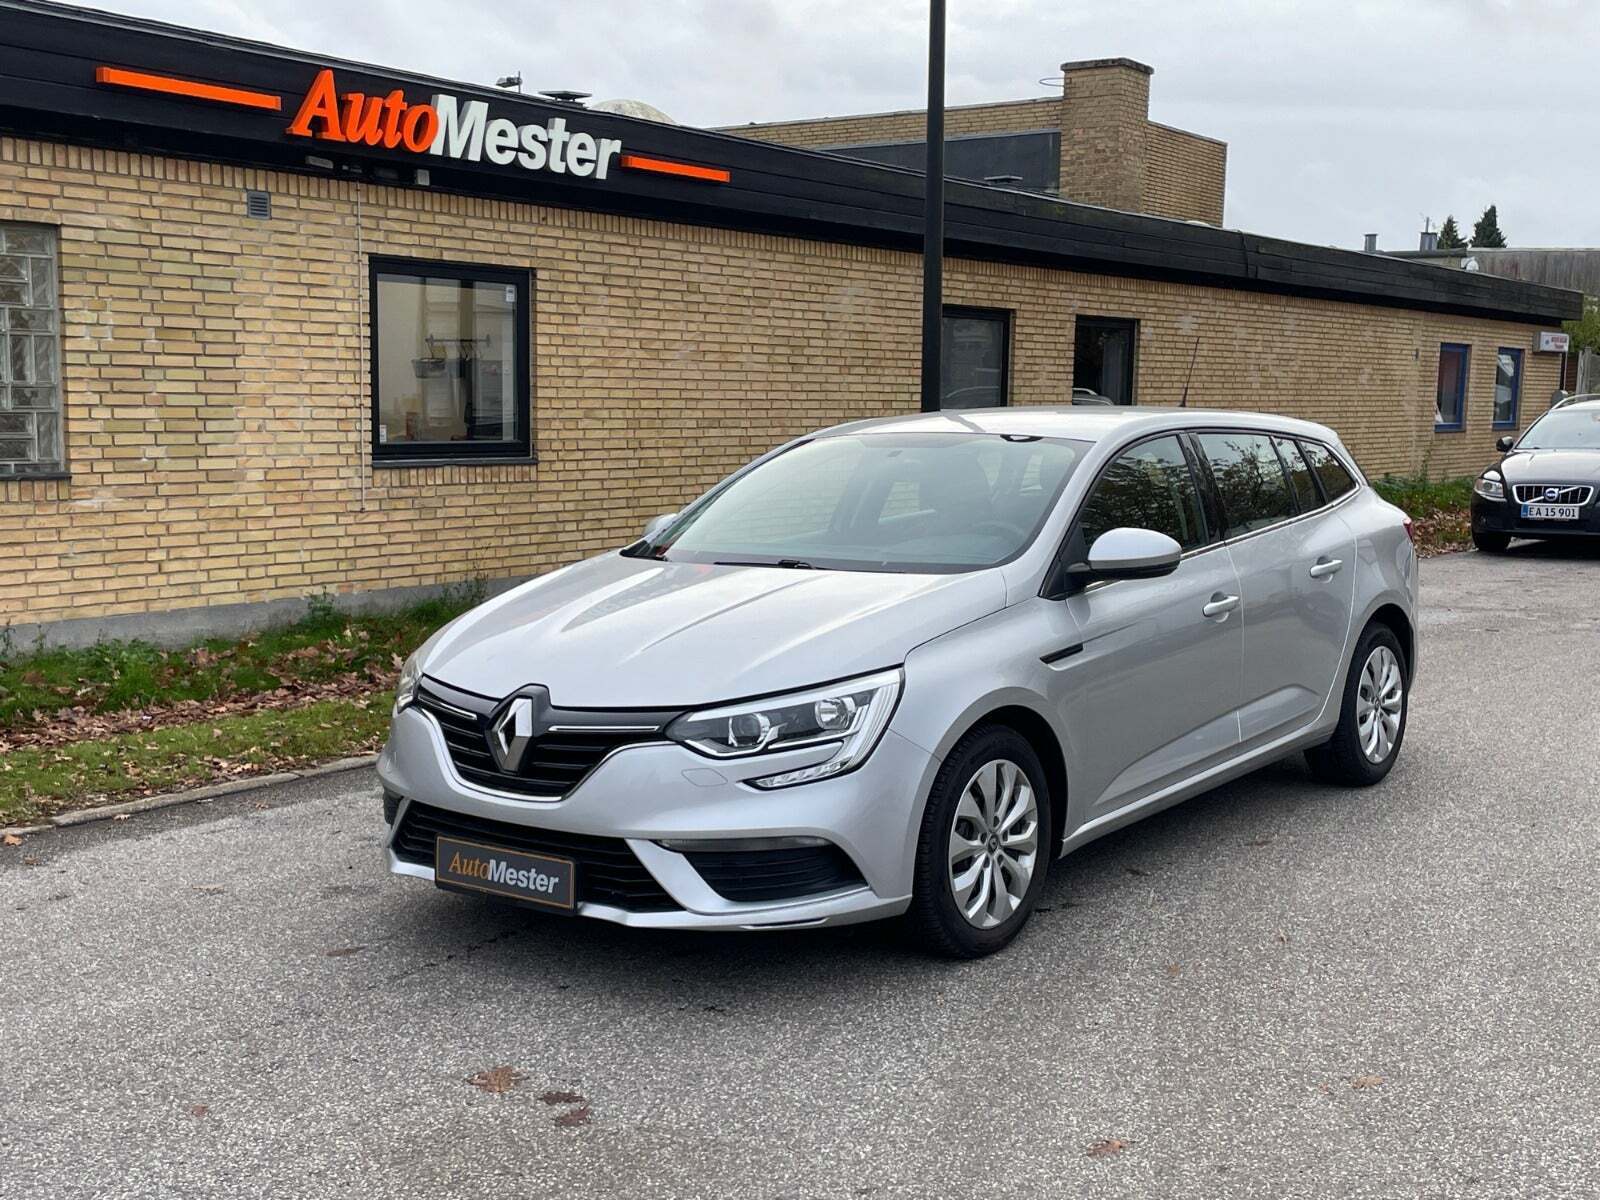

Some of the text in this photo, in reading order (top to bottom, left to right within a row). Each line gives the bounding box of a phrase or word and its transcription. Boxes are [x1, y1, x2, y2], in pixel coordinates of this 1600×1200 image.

[286, 69, 621, 180] AutoMester
[1528, 507, 1576, 518] EA 15 901
[447, 851, 559, 893] AutoMester
